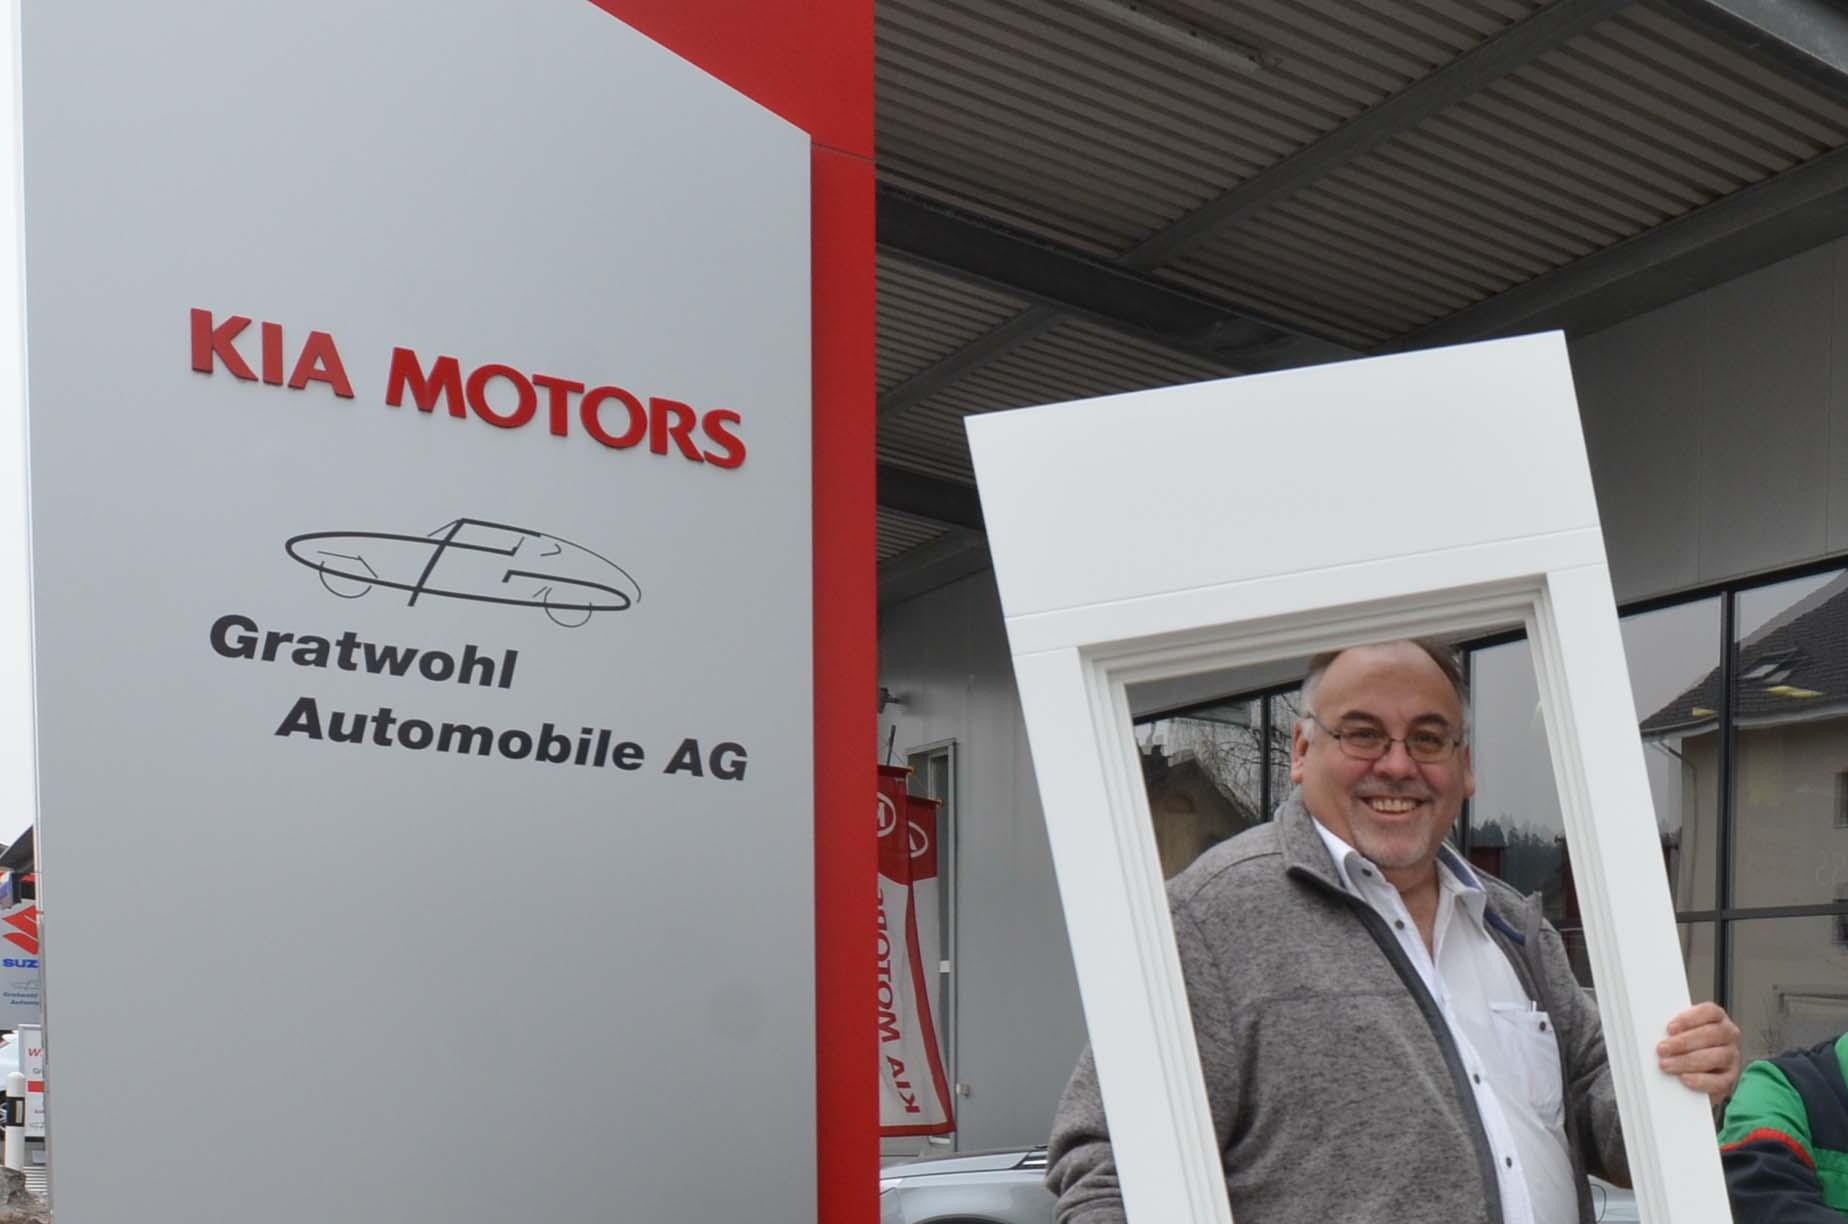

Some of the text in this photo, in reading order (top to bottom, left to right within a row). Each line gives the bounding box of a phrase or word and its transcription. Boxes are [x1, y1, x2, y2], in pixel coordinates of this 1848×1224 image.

[190, 307, 748, 469] KIA MOTORS
[209, 613, 519, 689] Gratwohl
[274, 696, 749, 782] Automobile AG
